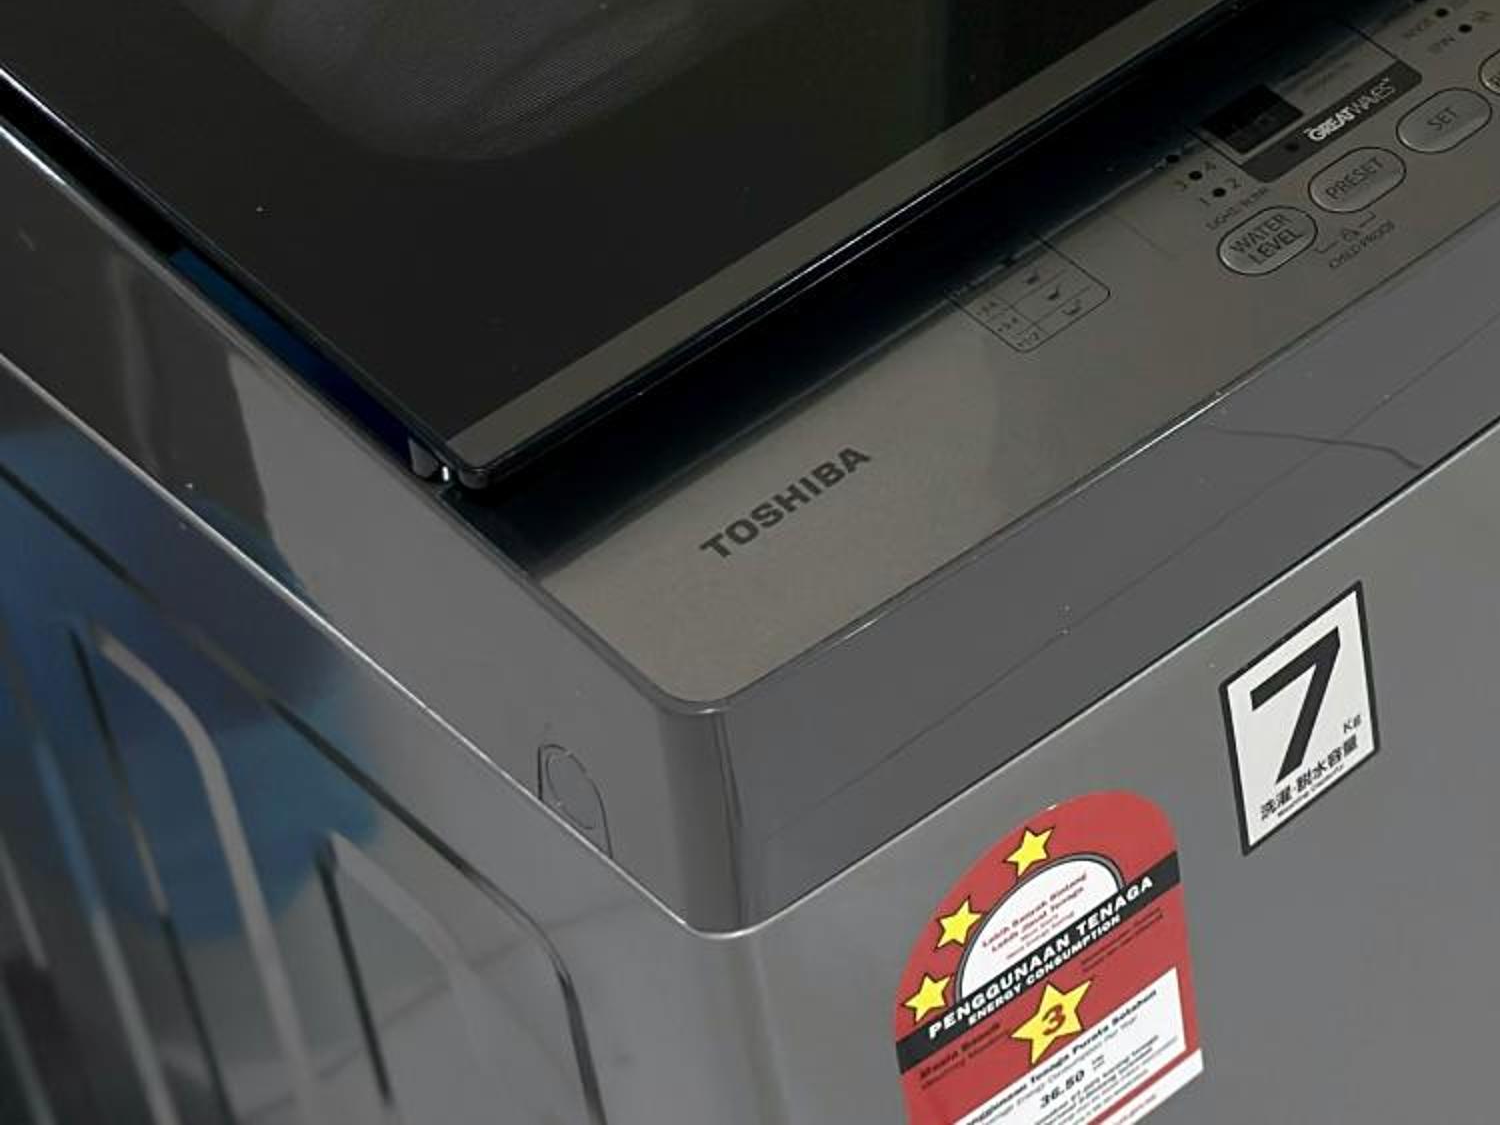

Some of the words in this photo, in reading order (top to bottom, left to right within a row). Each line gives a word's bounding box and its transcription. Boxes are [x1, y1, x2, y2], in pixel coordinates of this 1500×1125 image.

[1427, 106, 1458, 131] SET
[1326, 156, 1385, 200] PRESET
[1229, 213, 1293, 254] WATER
[1247, 228, 1305, 266] LEVEL
[699, 446, 872, 560] TOSHIBA
[1250, 626, 1341, 785] 7
[928, 933, 1071, 1041] PENGGUNAAN
[1075, 874, 1155, 938] TENAGA
[968, 980, 1023, 1027] ENERGY
[1025, 913, 1122, 986] CONSUMPTION
[1042, 1003, 1067, 1037] 3
[1039, 1069, 1086, 1109] 36.50
